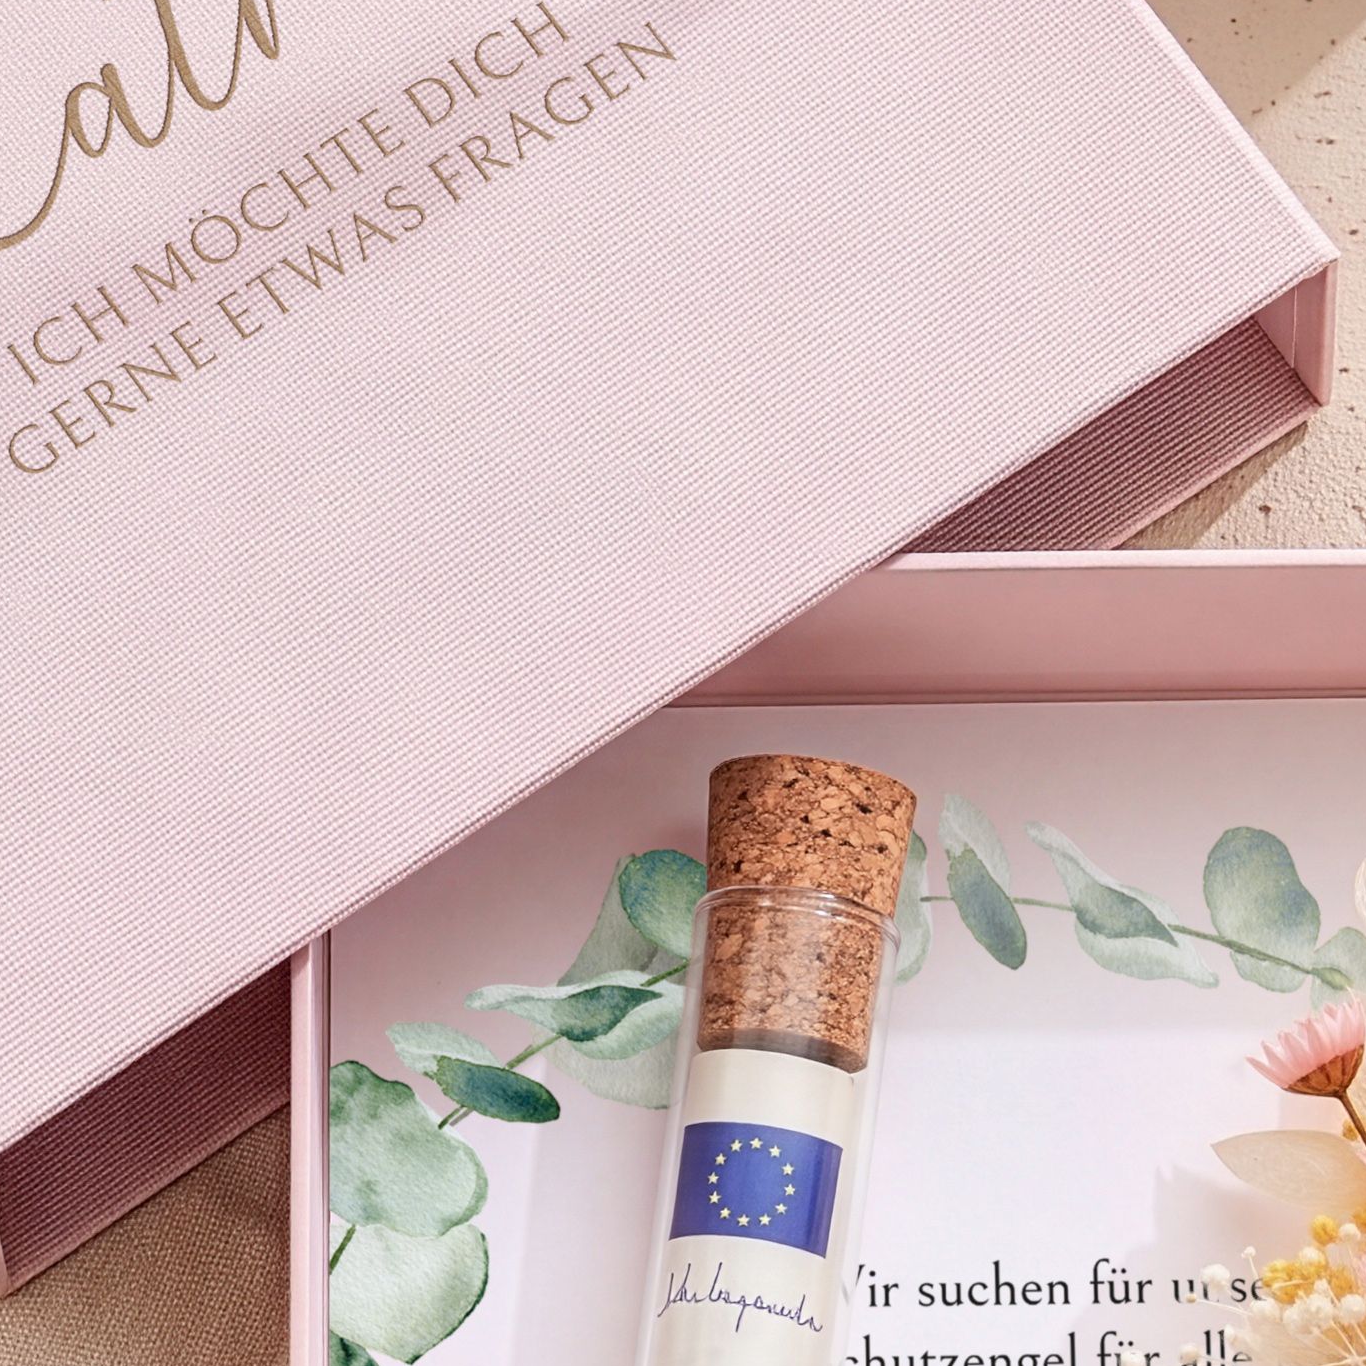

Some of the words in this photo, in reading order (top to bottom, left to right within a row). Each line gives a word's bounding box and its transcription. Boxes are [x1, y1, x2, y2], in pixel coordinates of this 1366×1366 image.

[7, 285, 129, 385] ICH
[132, 107, 405, 304] MÖCHTE
[403, 0, 570, 128] DICH
[7, 319, 218, 474] GERNE
[217, 184, 426, 339] ETWAS
[428, 21, 677, 202] FRAGEN
[856, 1263, 899, 1307] ir
[918, 1260, 1070, 1307] suchen
[1090, 1258, 1153, 1305] für
